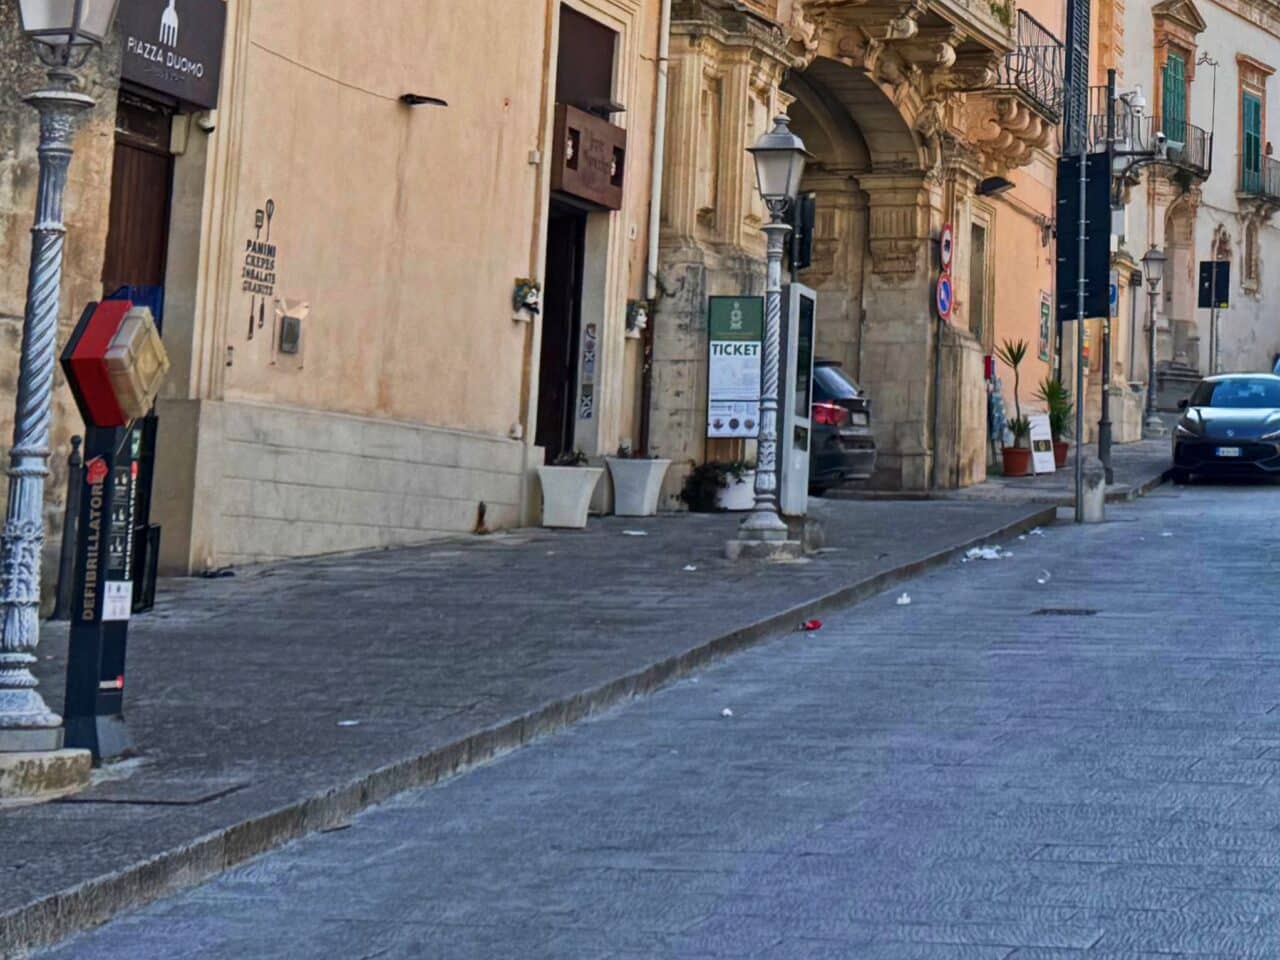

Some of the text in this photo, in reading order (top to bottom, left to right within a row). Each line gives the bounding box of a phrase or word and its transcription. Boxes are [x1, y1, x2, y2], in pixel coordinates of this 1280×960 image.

[127, 36, 164, 63] PIAZZA
[166, 51, 204, 78] DUOMO
[246, 239, 277, 258] PANINI
[245, 254, 275, 271] CREPES
[711, 343, 759, 356] TICKET
[82, 473, 105, 621] DEFIBRILLATORE
